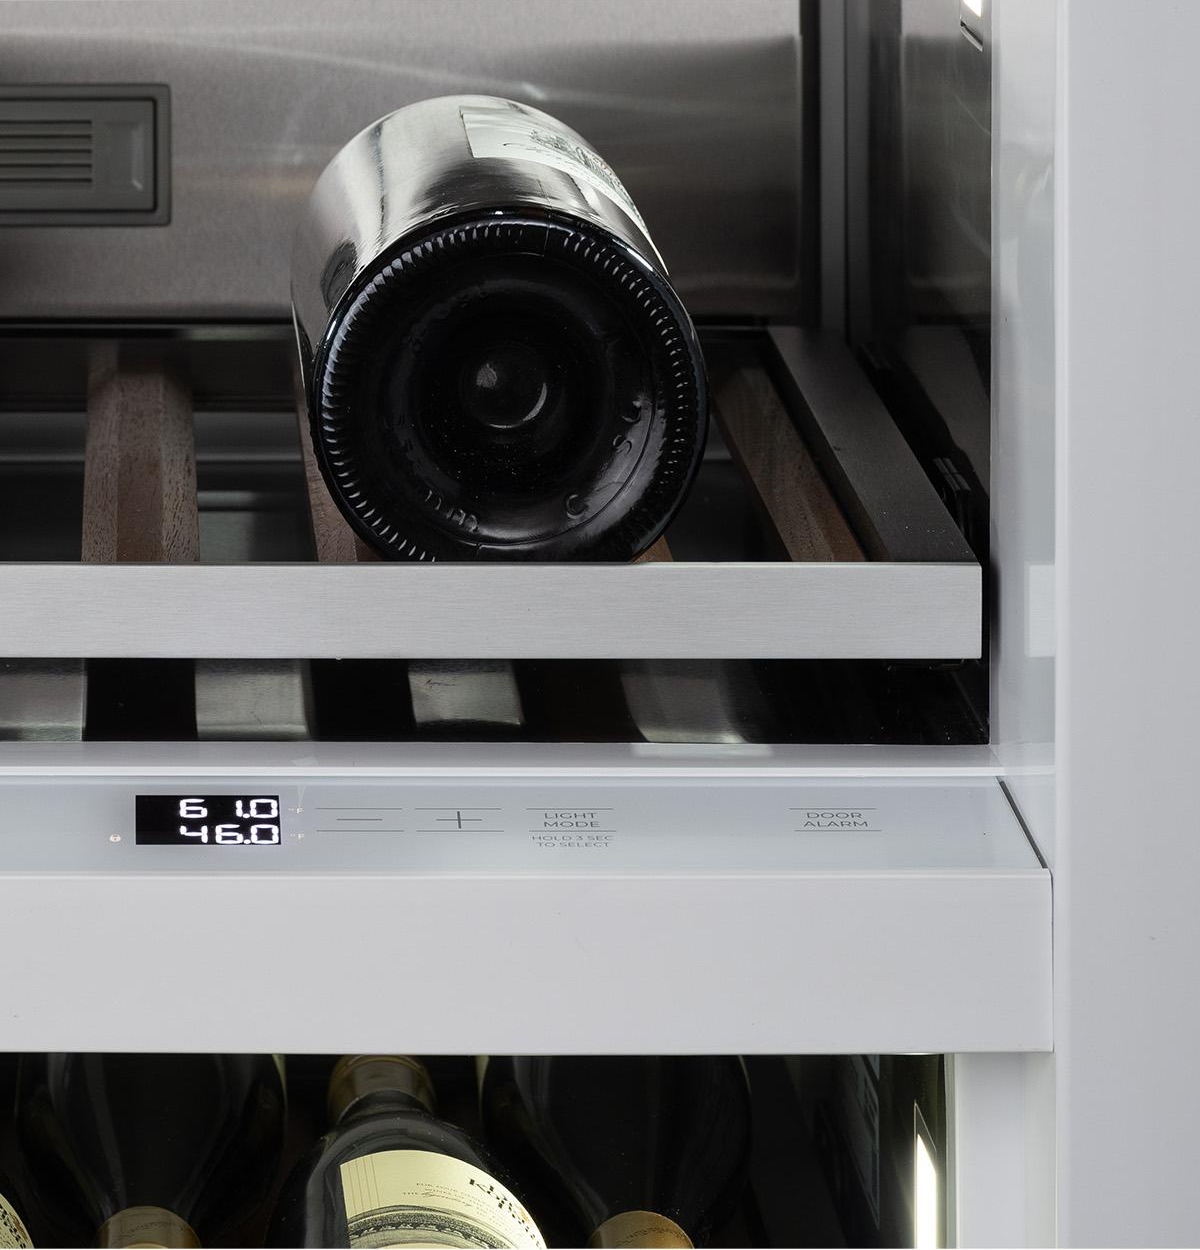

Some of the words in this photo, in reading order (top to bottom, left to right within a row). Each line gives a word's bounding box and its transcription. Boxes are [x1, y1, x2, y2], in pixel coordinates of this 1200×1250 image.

[543, 820, 601, 828] MODE
[803, 820, 868, 828] ALARM
[179, 823, 279, 845] 46.0
